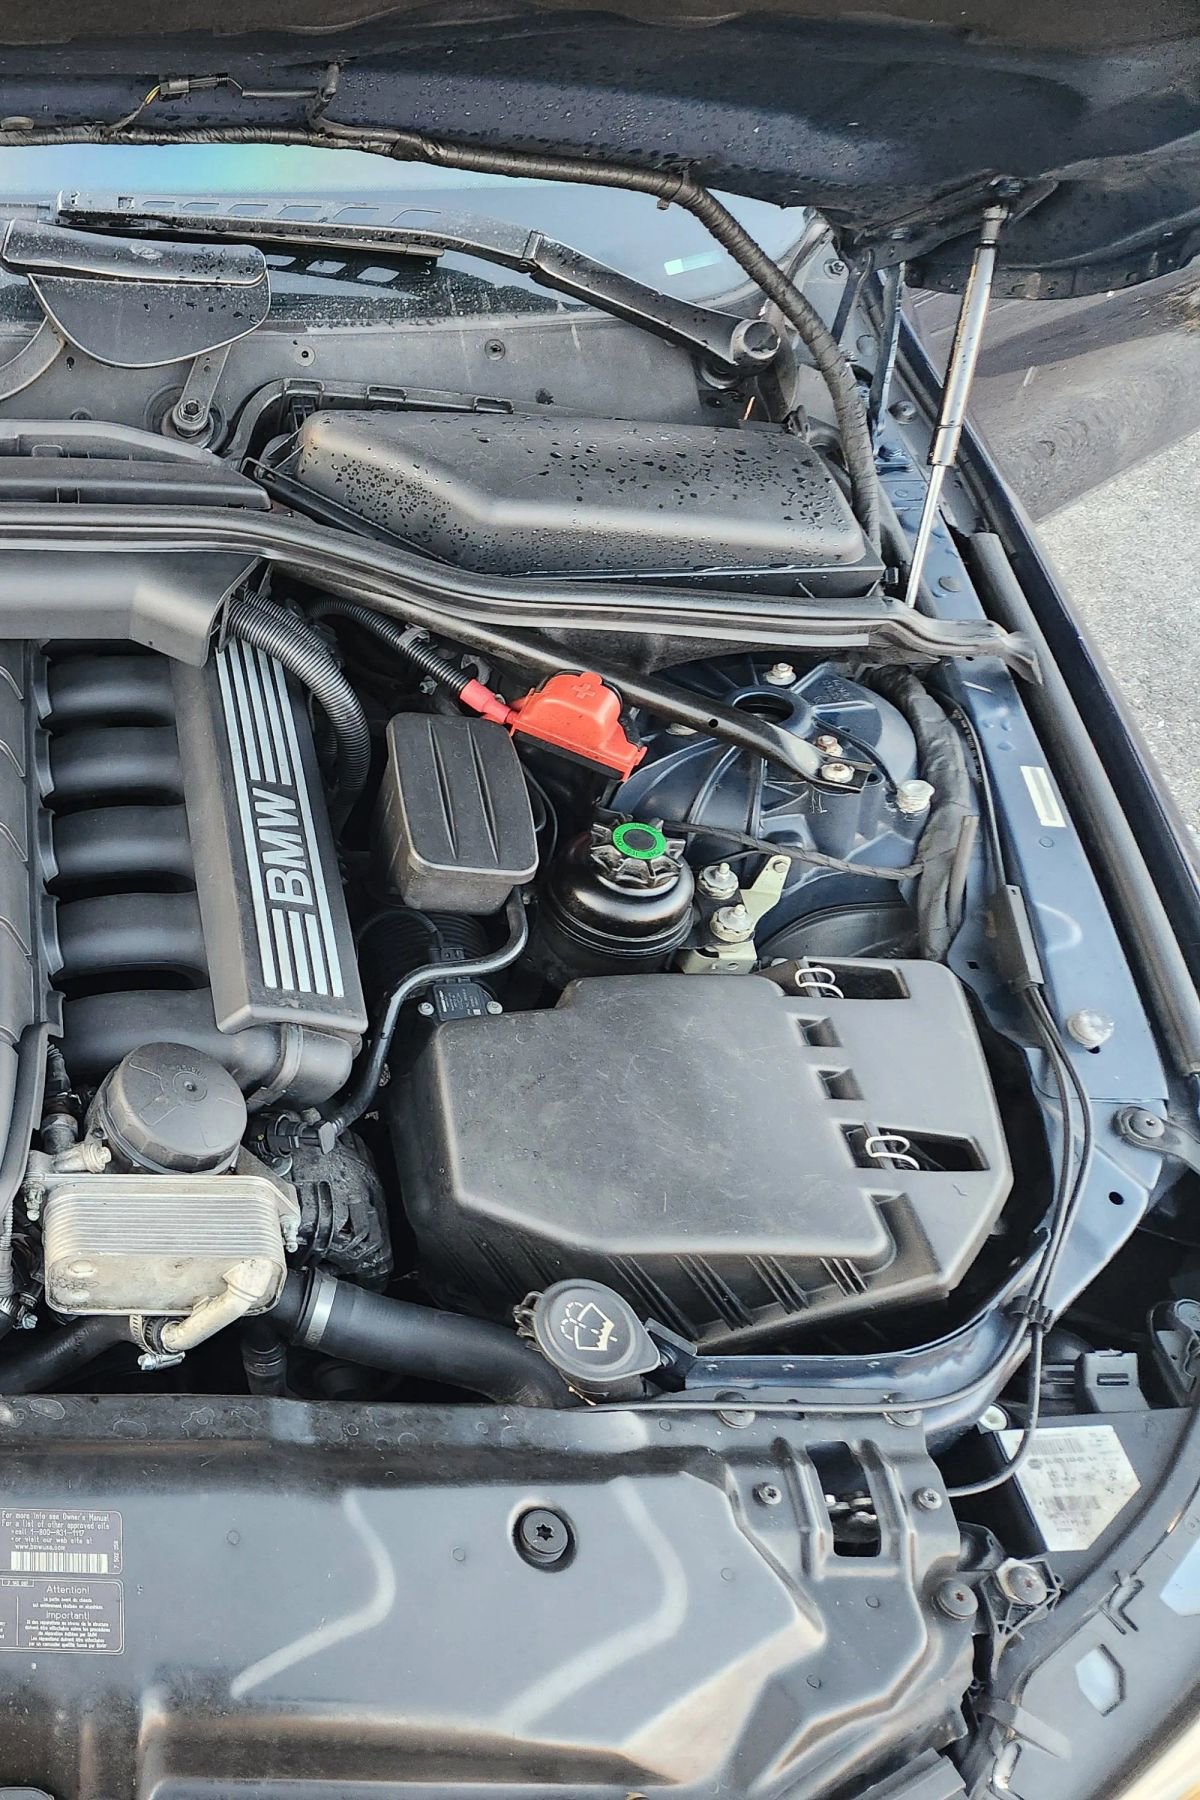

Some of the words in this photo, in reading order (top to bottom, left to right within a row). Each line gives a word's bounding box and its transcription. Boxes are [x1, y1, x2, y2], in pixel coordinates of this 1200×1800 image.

[252, 787, 313, 906] BMW
[1, 1510, 12, 1519] For
[62, 1512, 86, 1521] Owner's
[88, 1512, 109, 1522] Manual
[1, 1518, 12, 1527] For
[46, 1584, 90, 1594] Attention!
[46, 1610, 90, 1620] Important!
